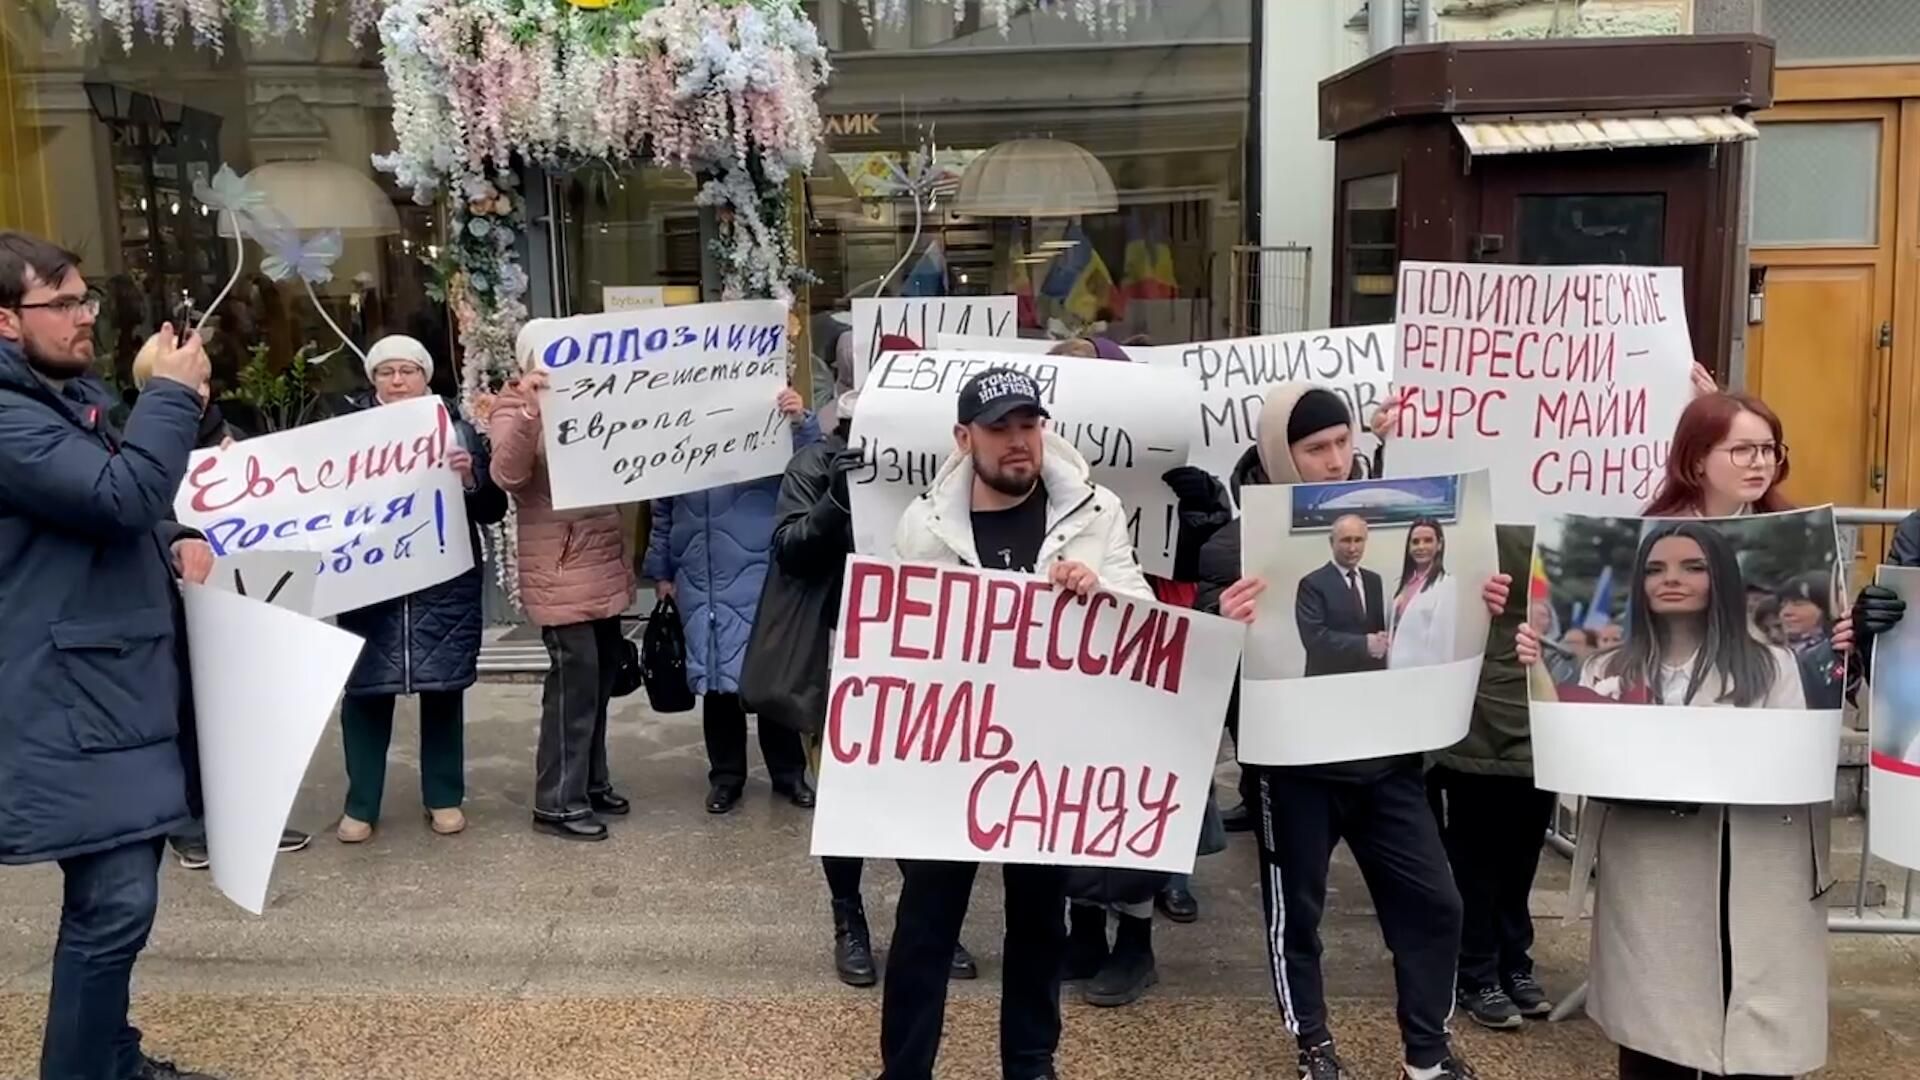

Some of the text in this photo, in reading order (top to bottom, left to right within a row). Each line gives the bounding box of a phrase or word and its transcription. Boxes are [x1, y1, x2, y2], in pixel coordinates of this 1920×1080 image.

[1401, 268, 1667, 328] ПОЛИТИЧЕСКИЕ
[543, 322, 785, 369] ОППОЗИЦИЯ
[1182, 331, 1385, 391] ФАШИЗМ
[1403, 323, 1616, 383] РЕПРЕССИИ
[977, 371, 1032, 390] TOMMY
[978, 381, 1037, 404] HILFIGER
[1396, 381, 1647, 440] КУРС МАЙИ
[188, 403, 450, 513] Евгения!
[557, 408, 696, 451] Европа
[203, 488, 416, 557] Россия
[844, 562, 1190, 695] РЕПРЕССИИ
[828, 676, 1014, 765] СТИЛЬ
[966, 760, 1181, 859] САНДУ
